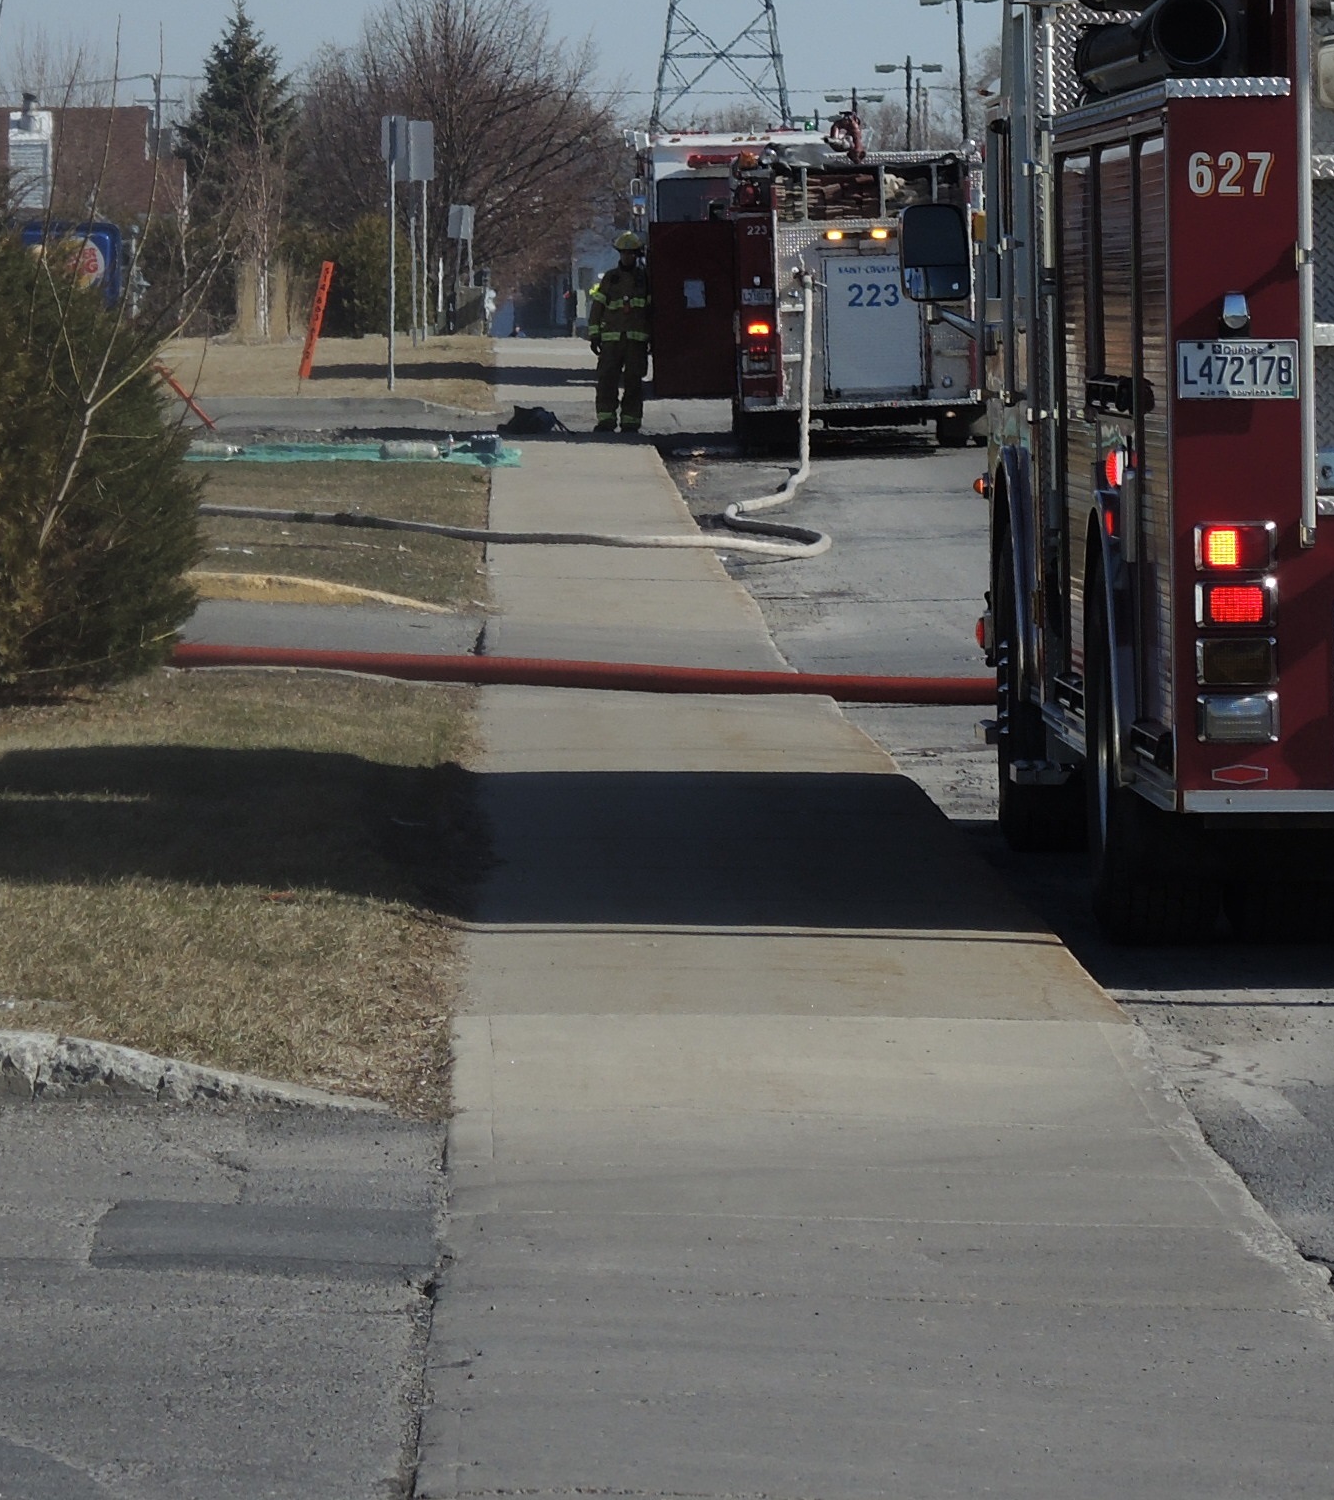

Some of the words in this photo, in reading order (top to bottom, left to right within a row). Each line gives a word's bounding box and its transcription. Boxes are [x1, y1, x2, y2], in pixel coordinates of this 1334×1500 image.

[1188, 151, 1274, 197] 627
[746, 225, 768, 236] 223
[848, 283, 900, 307] 223
[1223, 345, 1264, 355] Québec
[1183, 355, 1293, 385] L472178
